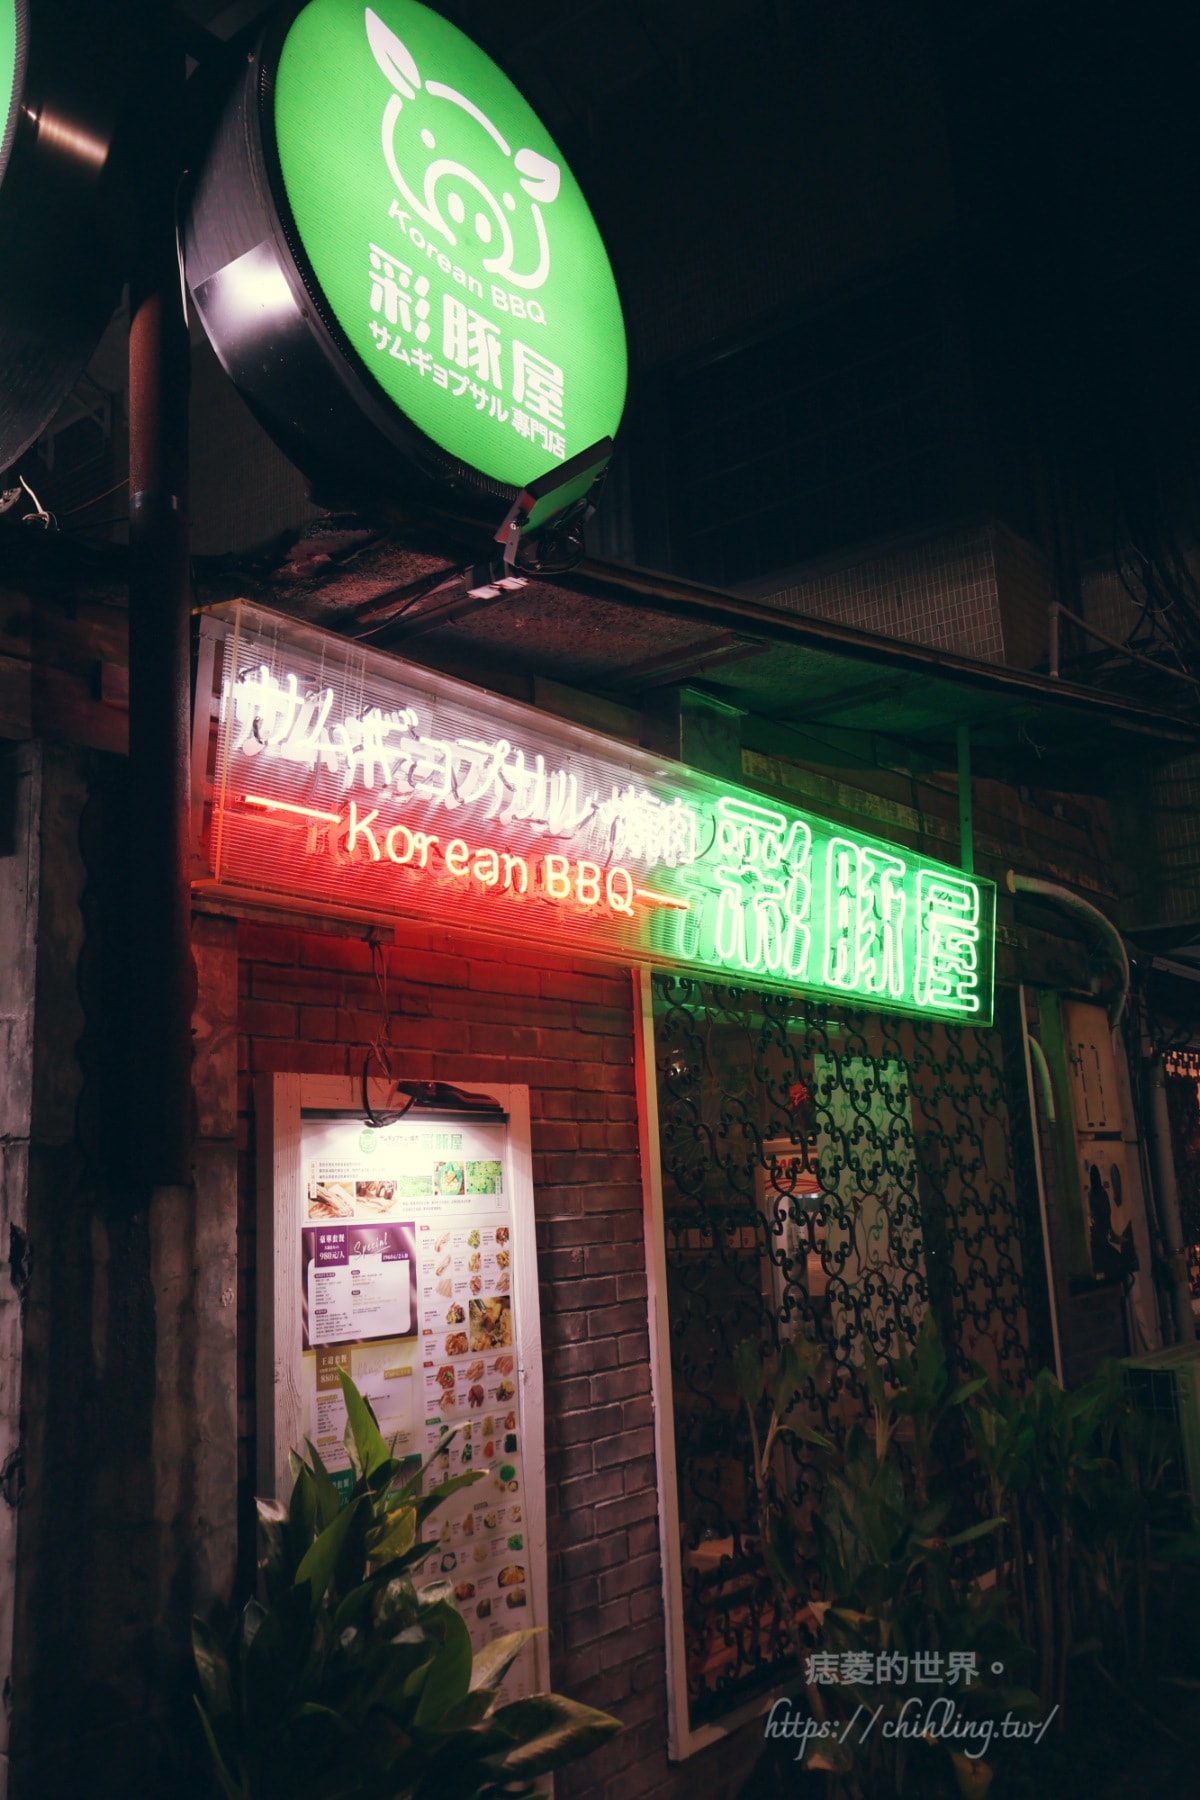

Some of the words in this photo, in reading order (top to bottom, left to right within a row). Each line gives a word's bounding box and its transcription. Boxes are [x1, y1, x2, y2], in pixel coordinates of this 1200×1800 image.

[388, 198, 484, 299] Korean
[490, 284, 548, 327] BBQ
[368, 242, 566, 431] 彩豚屋
[368, 319, 510, 424] サムギョプサル
[347, 801, 528, 894] Korean
[545, 854, 635, 917] BBQ
[713, 796, 980, 1013] 彩豚屋
